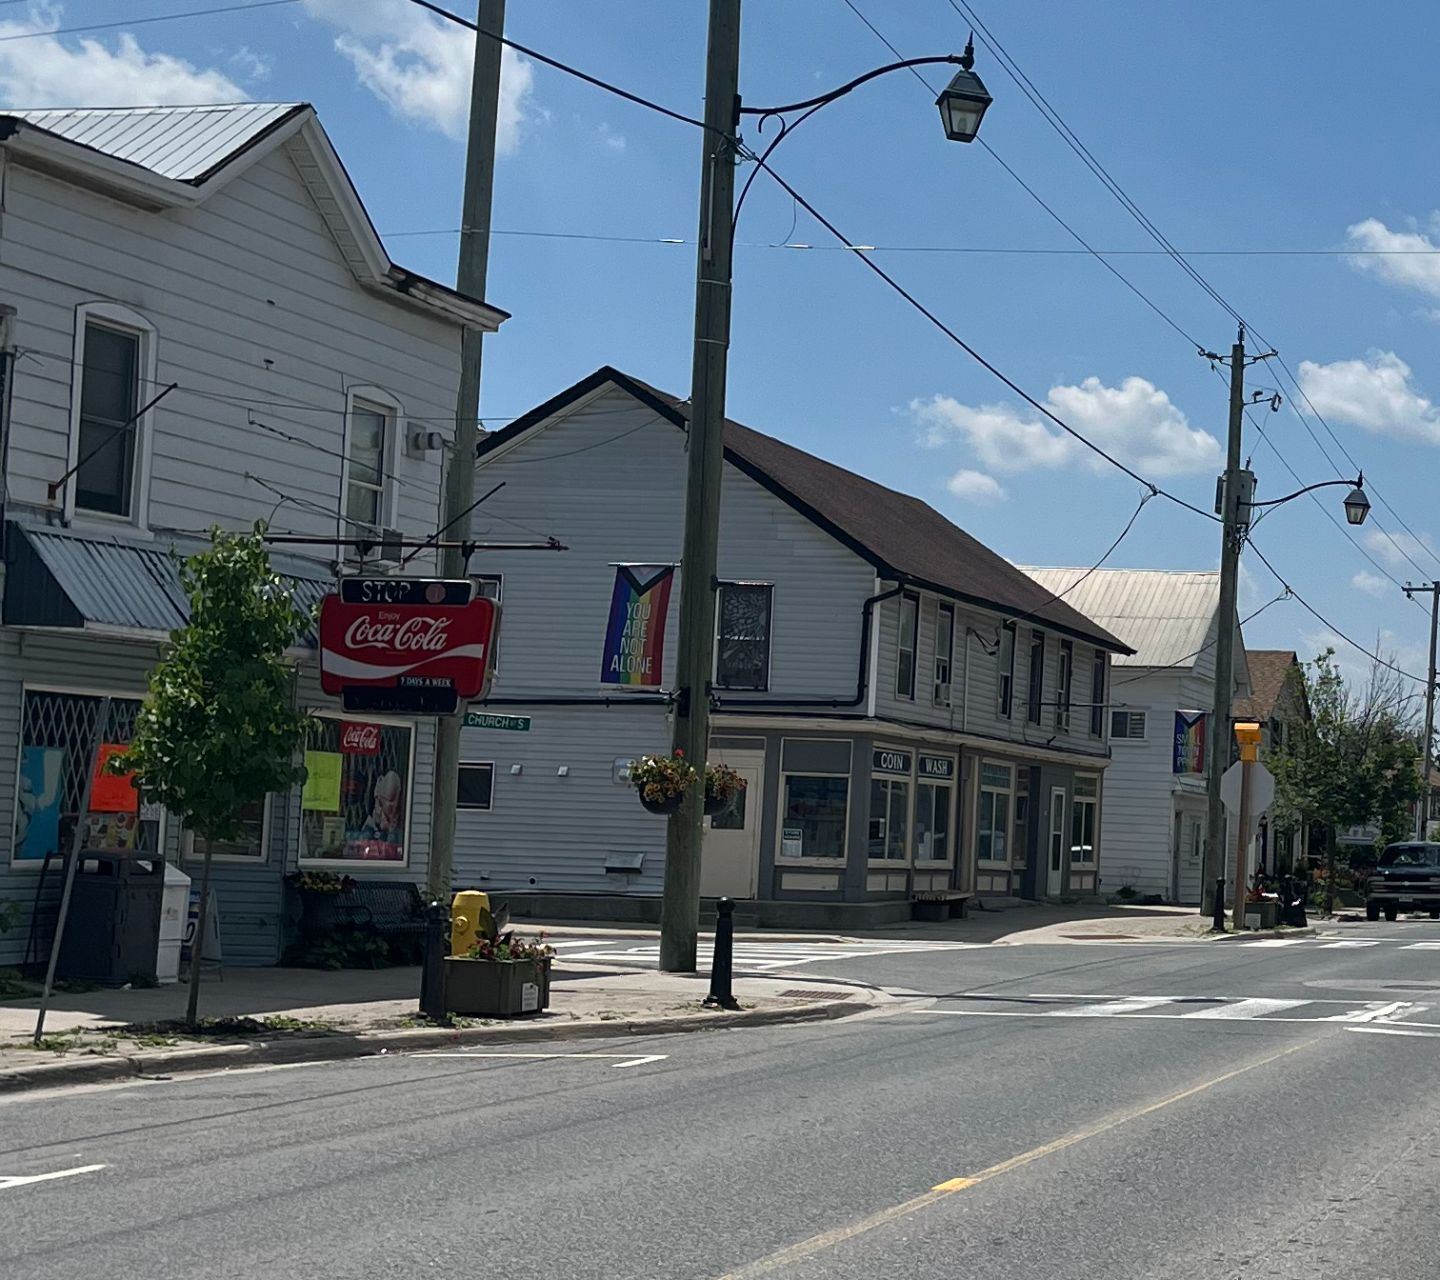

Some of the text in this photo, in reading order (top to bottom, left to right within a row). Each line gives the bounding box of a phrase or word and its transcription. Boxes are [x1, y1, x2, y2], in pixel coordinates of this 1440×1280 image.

[378, 611, 401, 621] Enjoy
[626, 602, 652, 619] YOU
[345, 616, 453, 651] Coca-Cola
[622, 620, 649, 637] ARE
[620, 638, 647, 655] NOT
[610, 655, 652, 674] ALONE
[406, 677, 424, 687] DAYS
[425, 678, 431, 687] A
[432, 678, 451, 688] WEEK
[468, 715, 510, 728] CHURCH
[517, 719, 525, 729] S
[880, 753, 948, 775] COIN WASH
